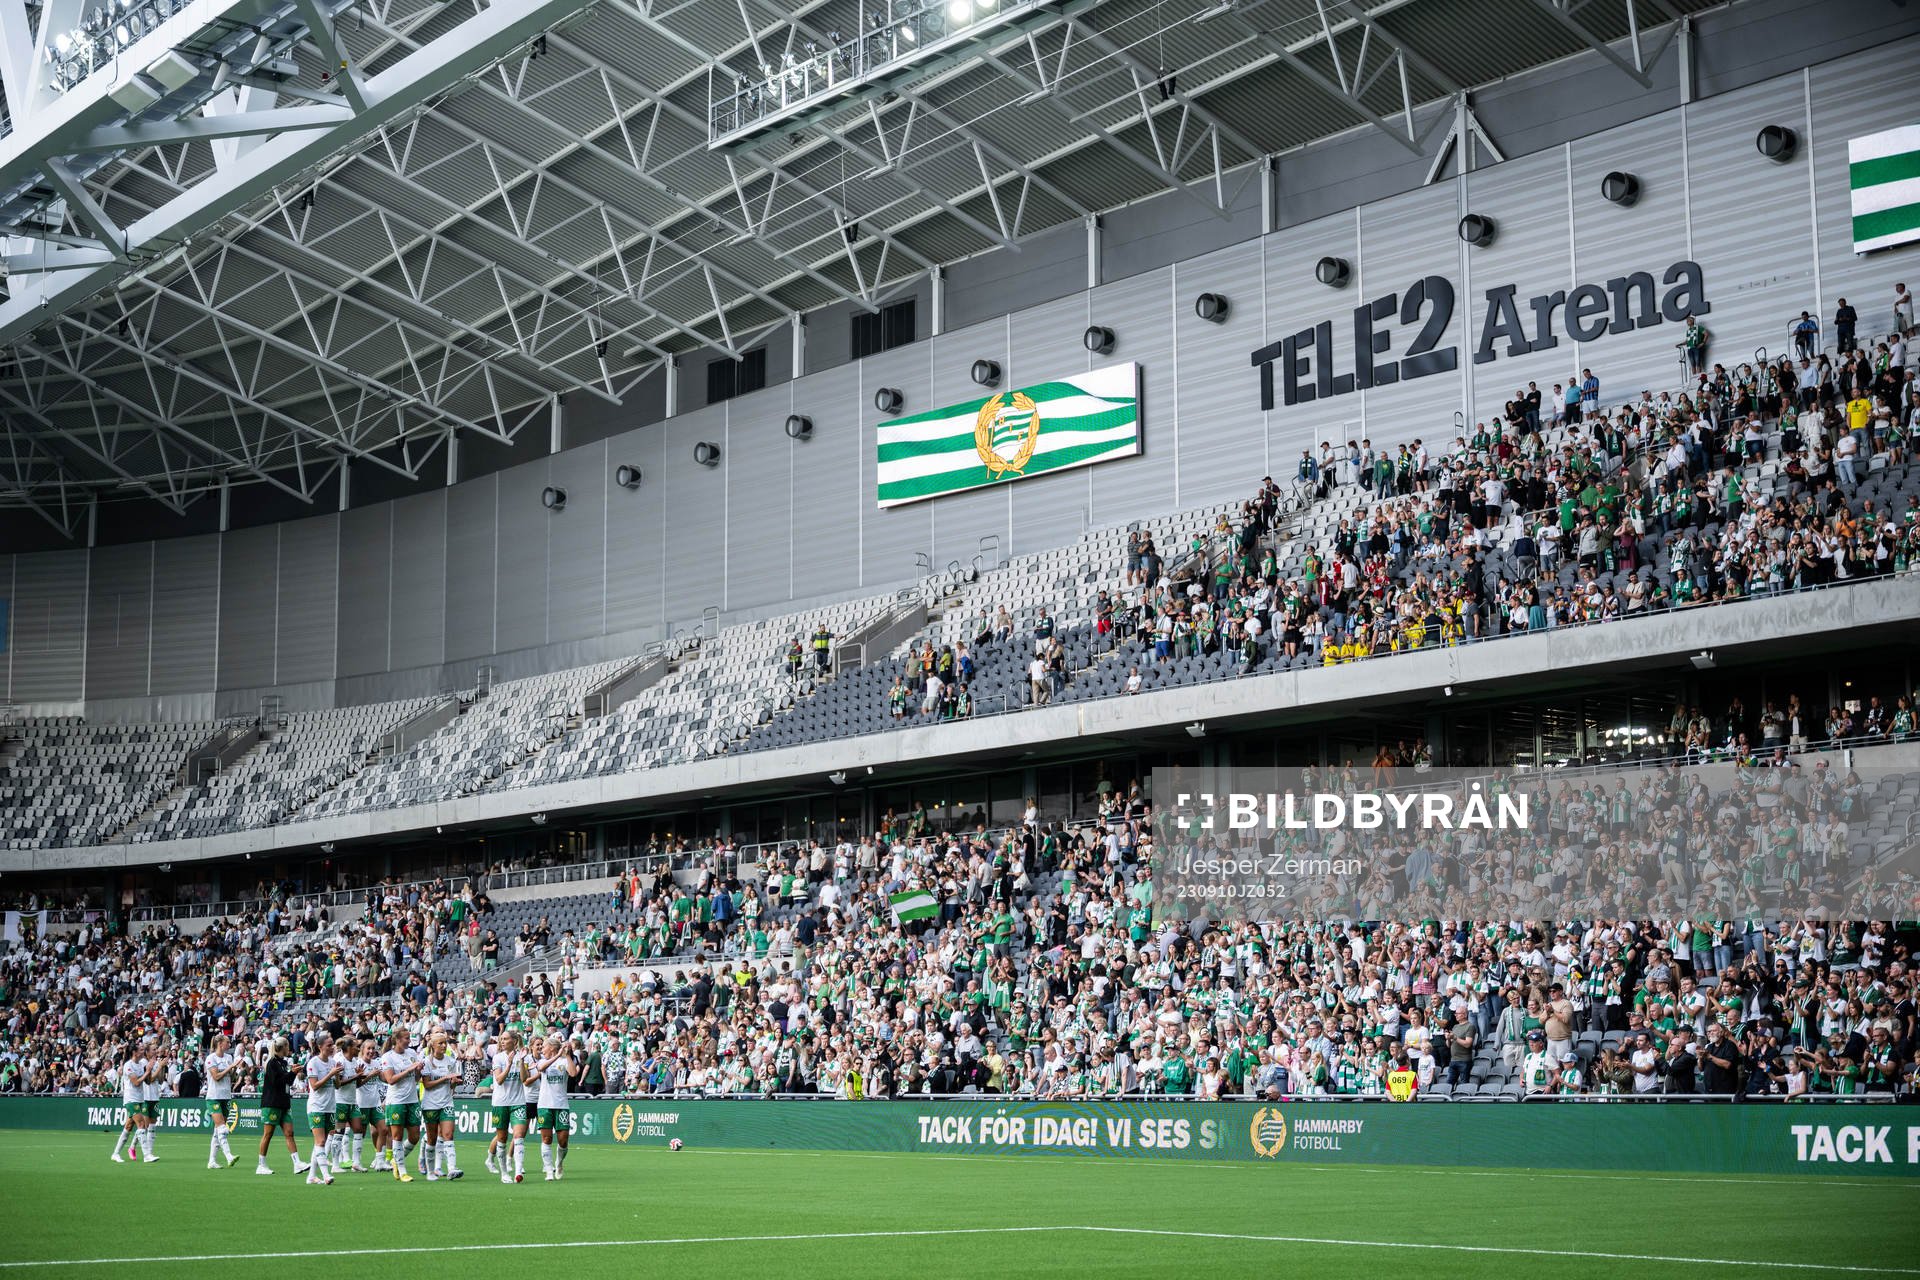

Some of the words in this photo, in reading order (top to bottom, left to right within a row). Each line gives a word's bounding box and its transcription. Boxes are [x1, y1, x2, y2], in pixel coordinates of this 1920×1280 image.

[1251, 275, 1457, 411] TELE2
[1474, 260, 1711, 364] Arena
[1392, 1076, 1407, 1084] 069
[88, 1107, 112, 1125] TACK
[168, 1109, 178, 1127] VI
[180, 1109, 201, 1128] SES
[638, 1113, 679, 1124] HAMMARBY
[637, 1125, 666, 1136] FOTBOLL
[918, 1116, 972, 1144] TACK
[980, 1108, 1025, 1145] FÖR
[1033, 1117, 1098, 1147] IDAG!
[1106, 1118, 1131, 1148] VI
[1139, 1118, 1191, 1149] SES
[1294, 1119, 1364, 1134] HAMMARBY
[1294, 1135, 1342, 1151] FOTBOLL
[1791, 1125, 1893, 1163] TACK
